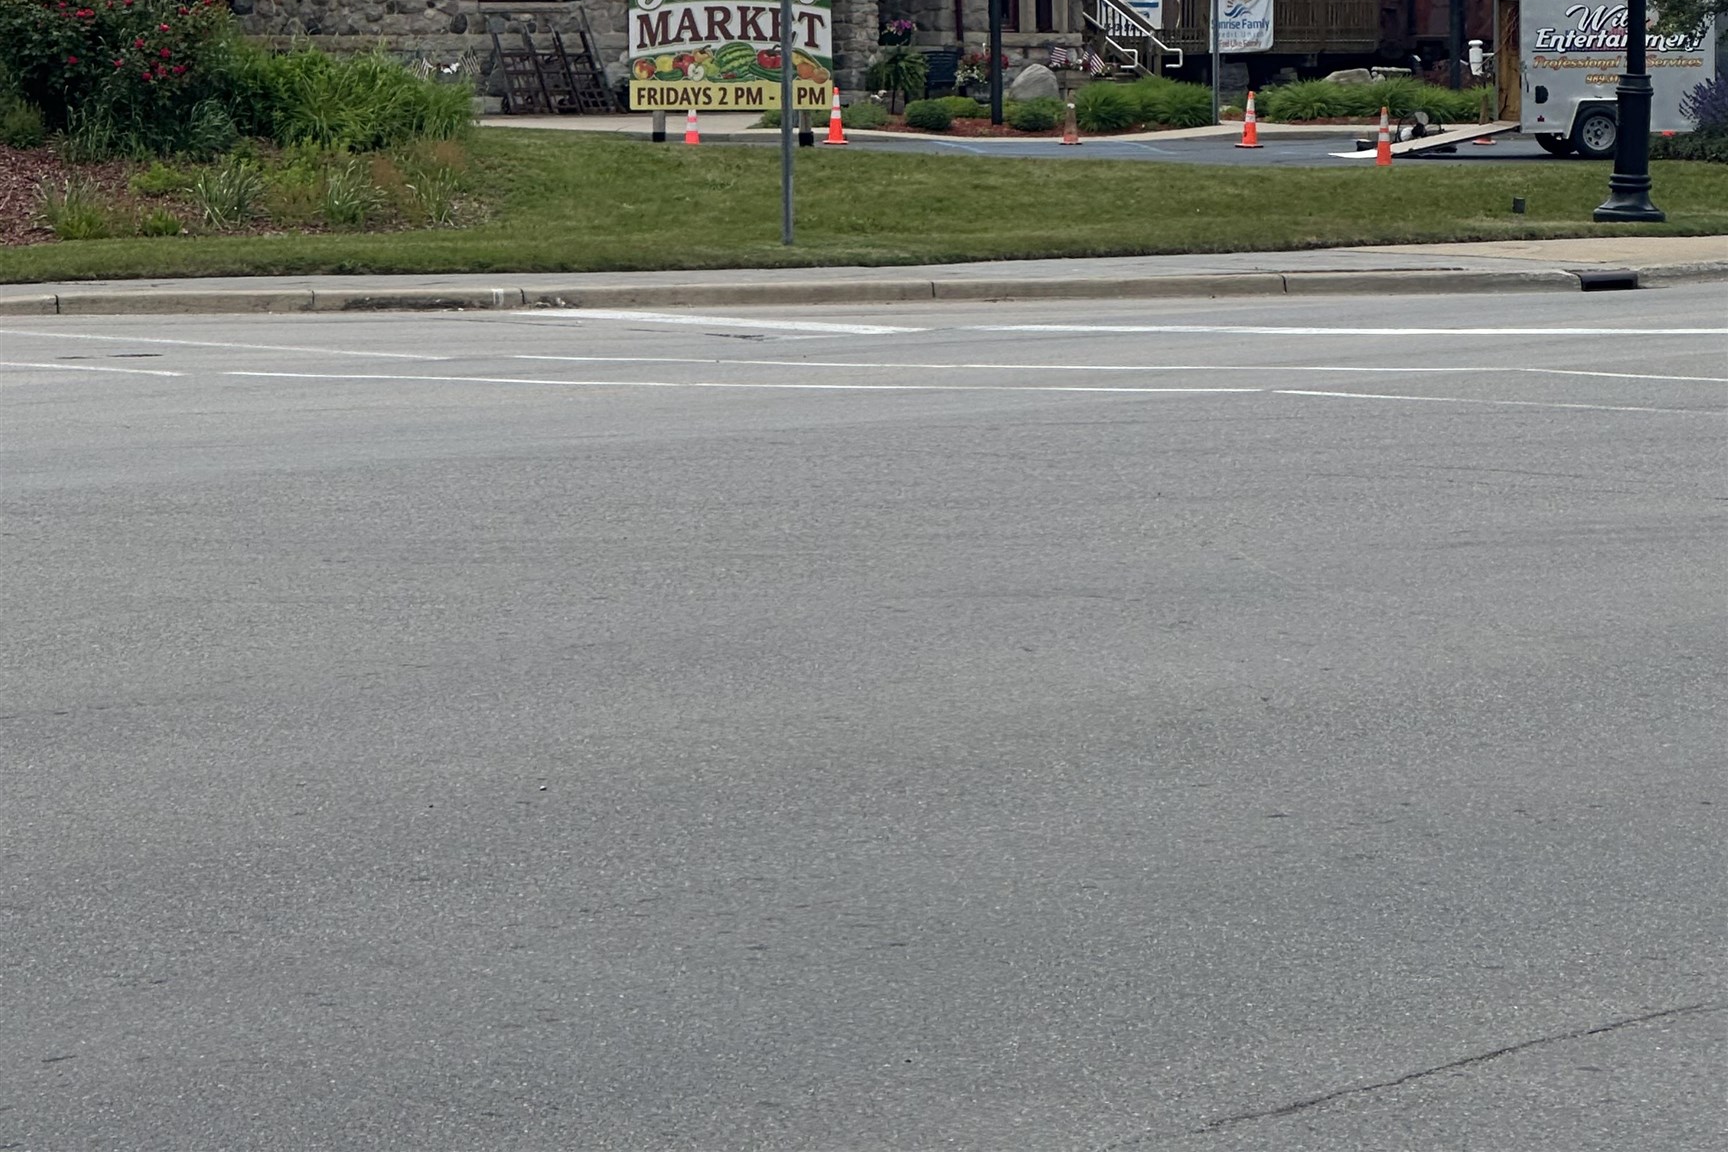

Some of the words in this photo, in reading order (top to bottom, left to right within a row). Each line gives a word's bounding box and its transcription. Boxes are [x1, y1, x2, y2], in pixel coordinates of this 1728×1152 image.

[636, 6, 825, 48] MARKET
[1242, 17, 1270, 32] Family
[1535, 28, 1701, 53] Entertaiment
[1533, 54, 1621, 70] Professional
[1646, 54, 1704, 68] Services
[636, 87, 713, 106] FRIDAYS
[718, 87, 729, 105] 2
[734, 87, 763, 105] PM
[797, 87, 826, 105] PM
